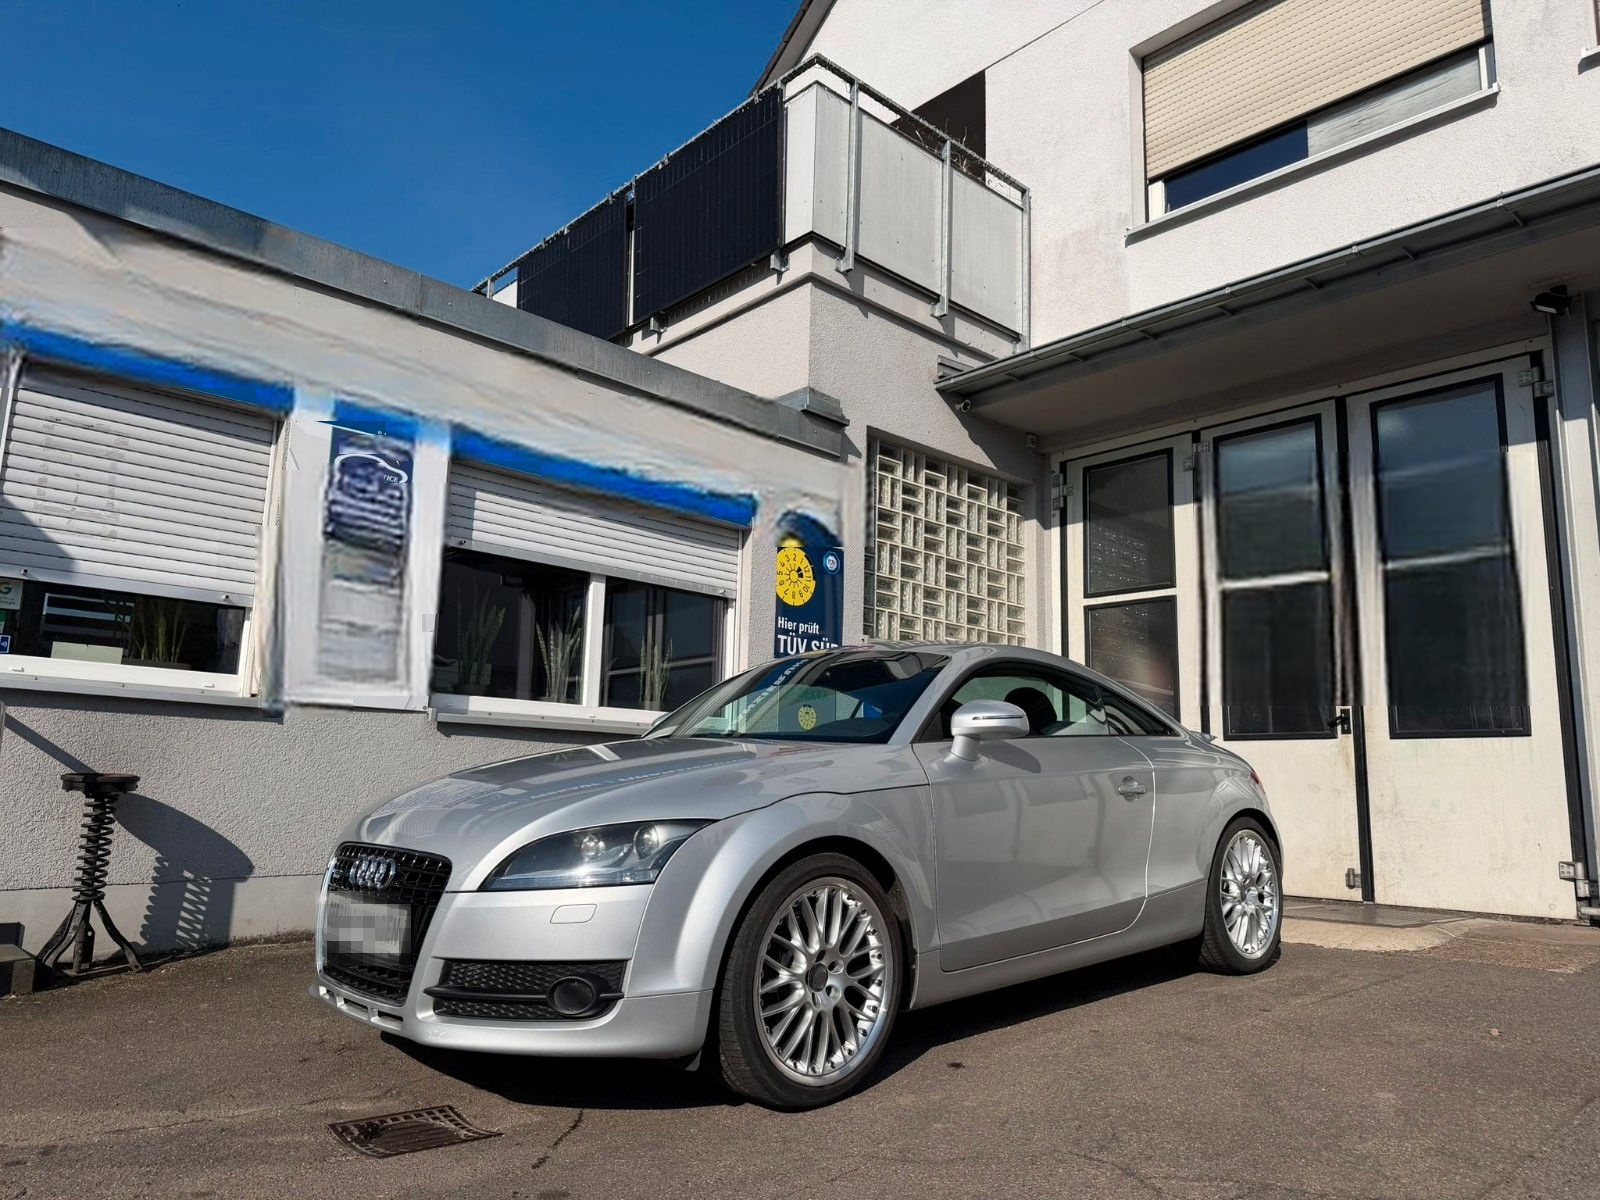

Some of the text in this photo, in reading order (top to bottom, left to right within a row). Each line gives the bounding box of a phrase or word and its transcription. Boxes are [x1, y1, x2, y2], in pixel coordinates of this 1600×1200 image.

[777, 616, 820, 635] Hier prüft
[777, 632, 808, 656] TÜV
